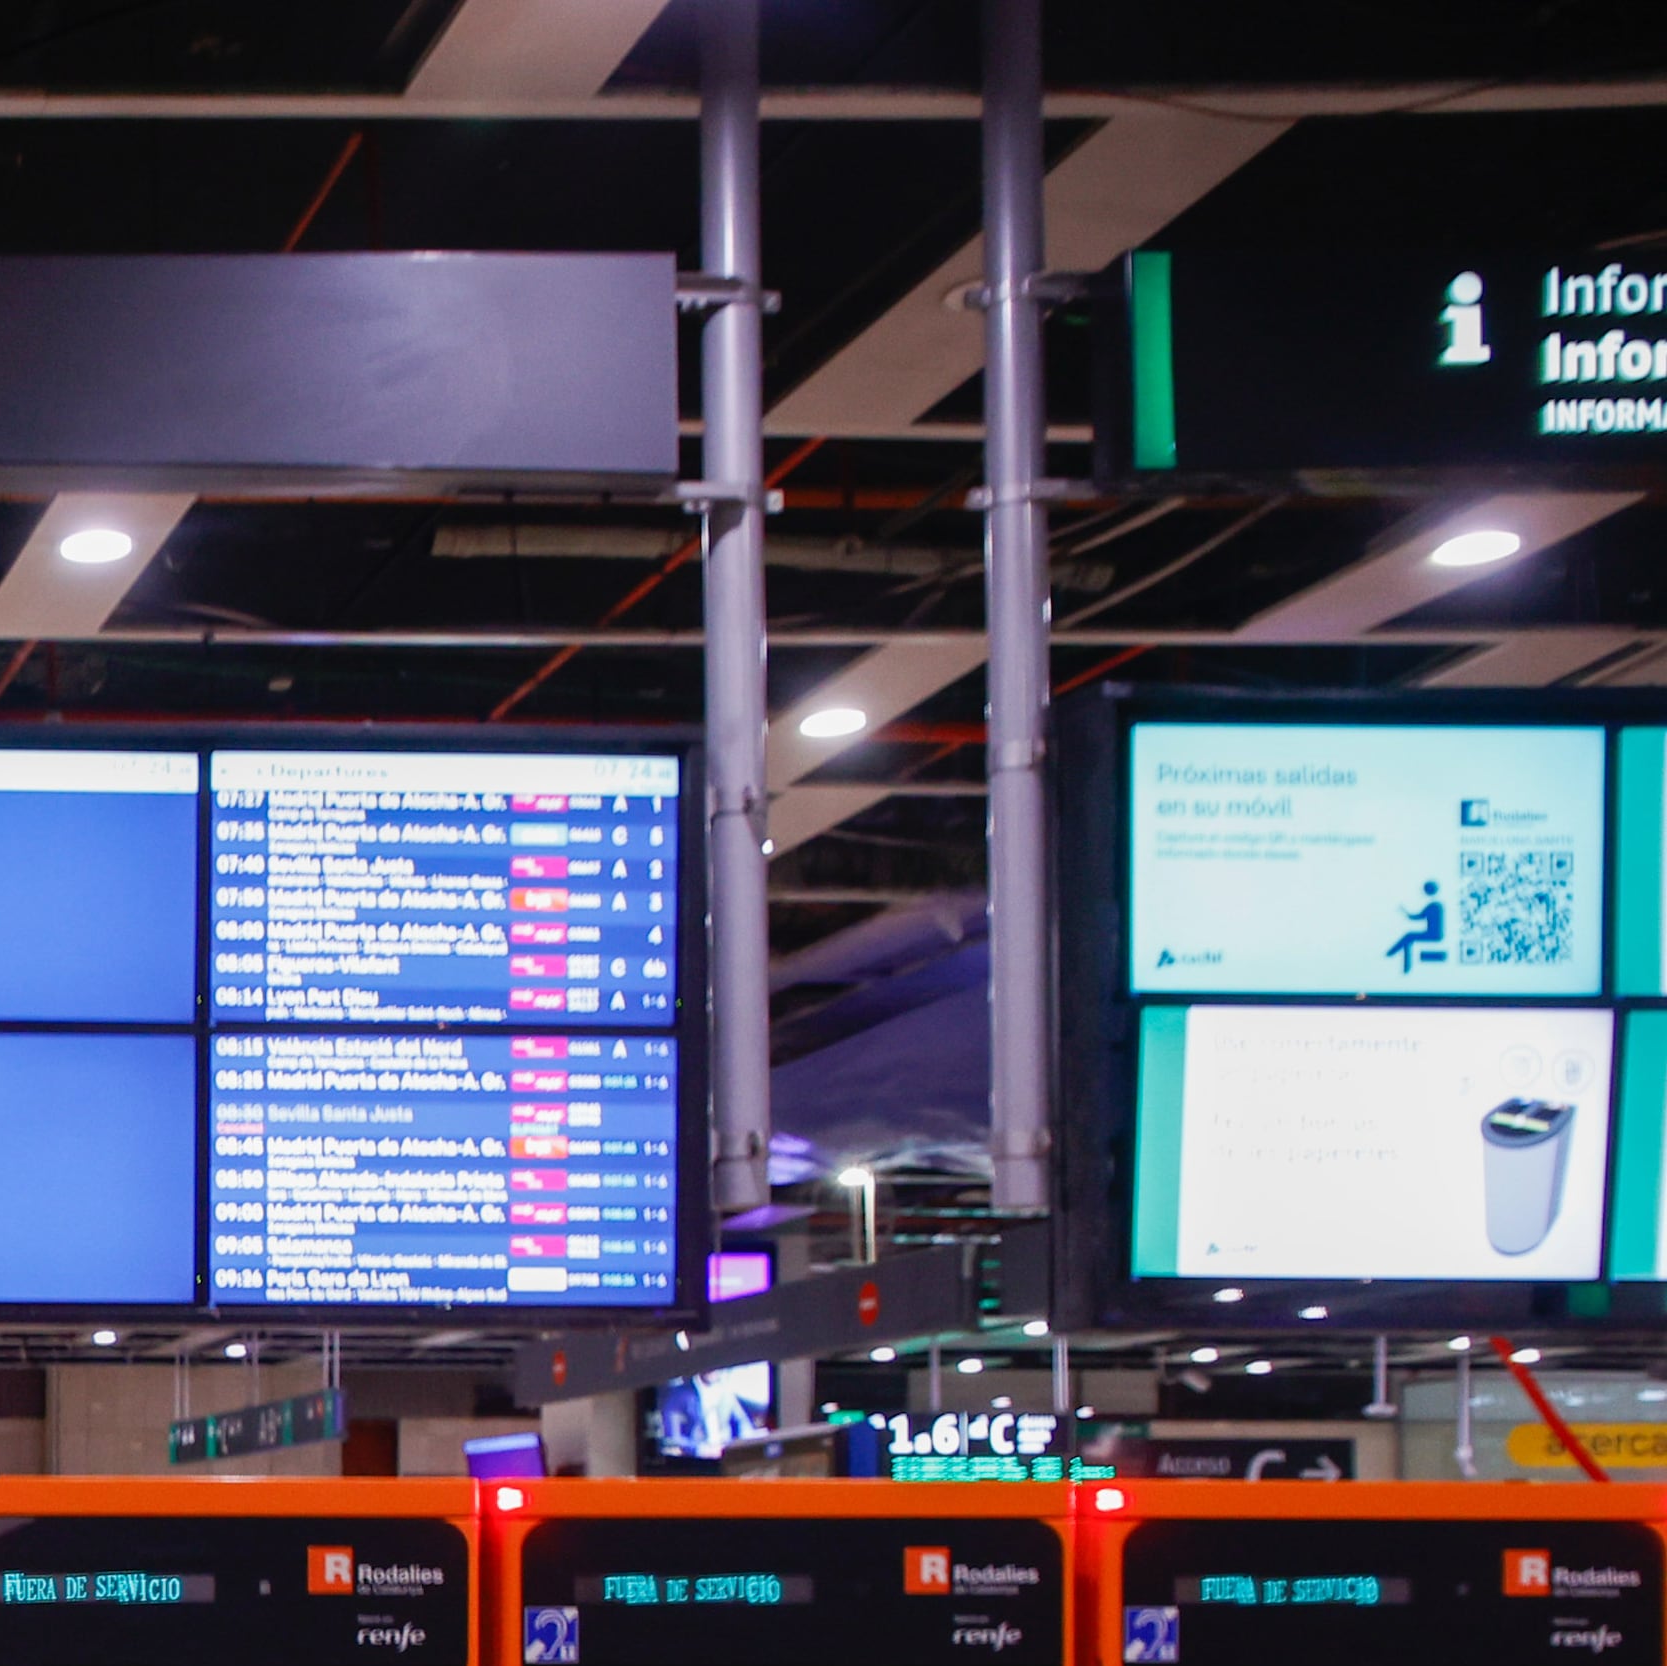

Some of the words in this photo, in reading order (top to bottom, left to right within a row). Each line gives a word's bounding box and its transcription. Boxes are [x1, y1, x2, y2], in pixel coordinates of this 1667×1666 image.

[1155, 762, 1267, 787] Próximas
[1274, 763, 1359, 787] salidas
[1227, 795, 1294, 818] móvil
[1547, 1432, 1667, 1457] aerca
[324, 1553, 352, 1584] R
[357, 1563, 444, 1585] Rodalies
[920, 1554, 947, 1585] R
[953, 1563, 1040, 1586] Rodalies
[2, 1571, 58, 1602] FUERA
[65, 1575, 88, 1601] DE
[94, 1572, 182, 1603] SERVICIO
[356, 1620, 427, 1653] renfe
[952, 1620, 1022, 1653] renfe
